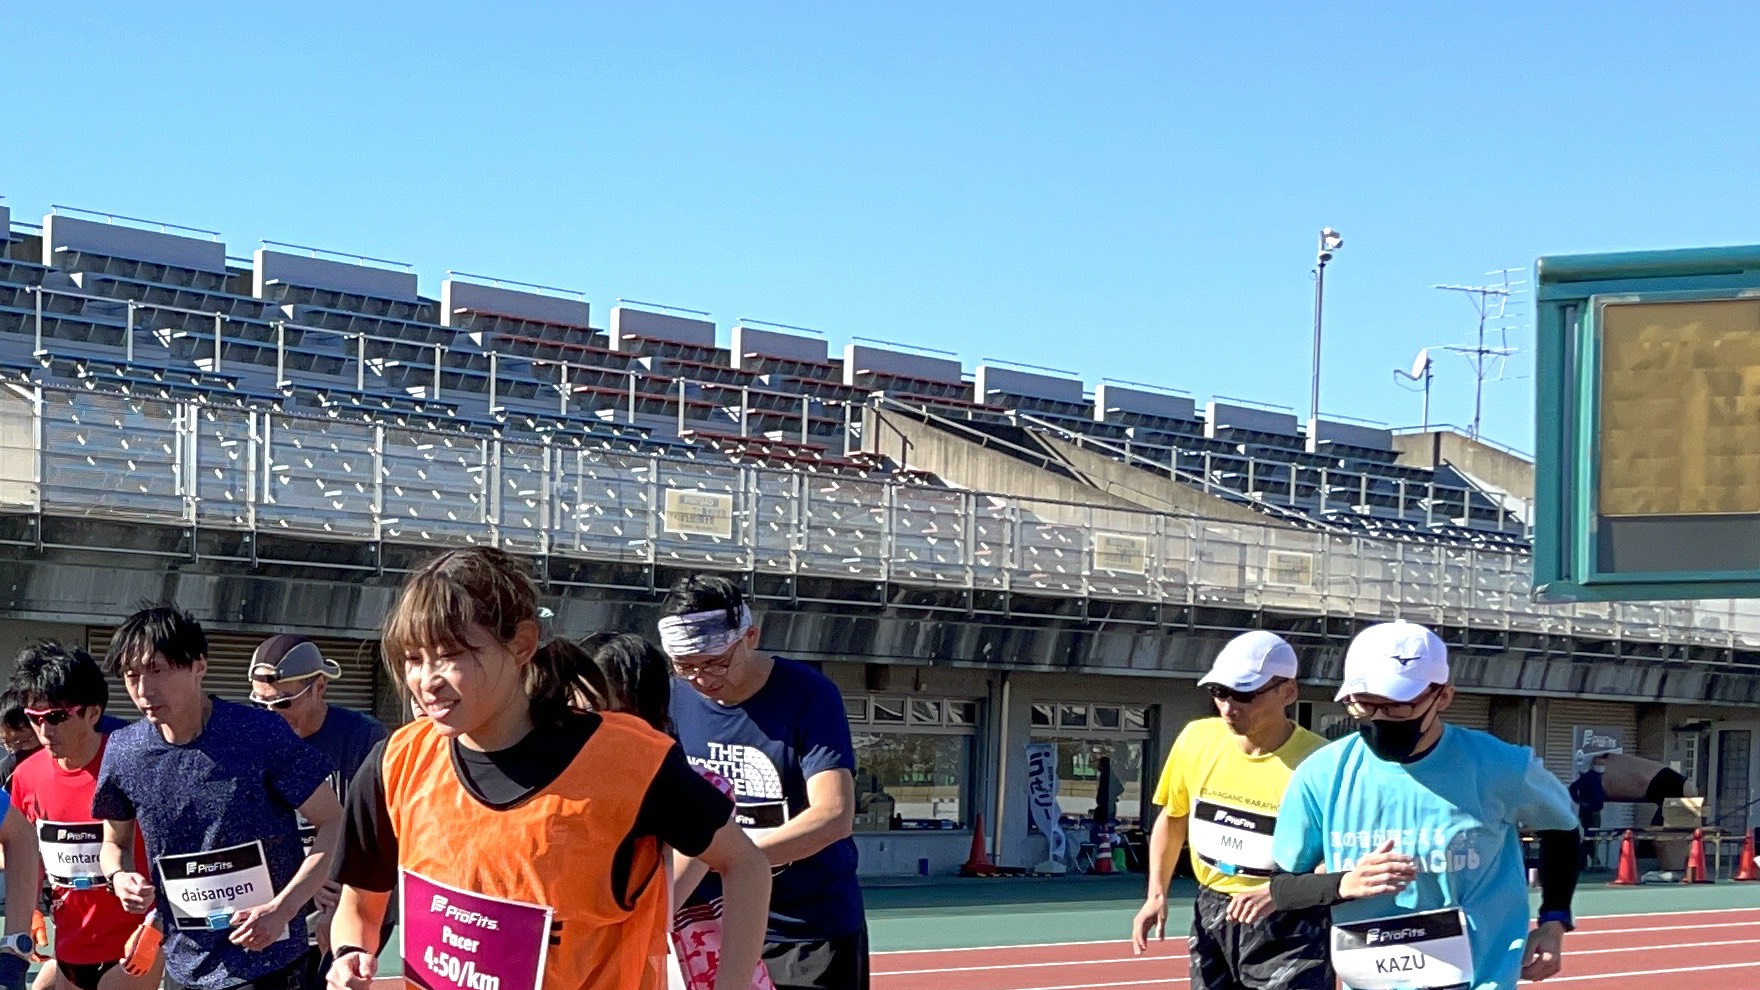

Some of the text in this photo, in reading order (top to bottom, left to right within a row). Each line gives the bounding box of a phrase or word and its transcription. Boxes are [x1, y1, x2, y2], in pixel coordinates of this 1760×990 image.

[707, 742, 744, 761] THE
[1221, 835, 1243, 850] MM
[198, 861, 234, 874] ProFits
[182, 880, 254, 902] daisangen
[445, 905, 499, 930] ProFits
[441, 925, 480, 953] Pacer
[1380, 928, 1426, 942] ProFits
[1375, 953, 1426, 973] KAZU
